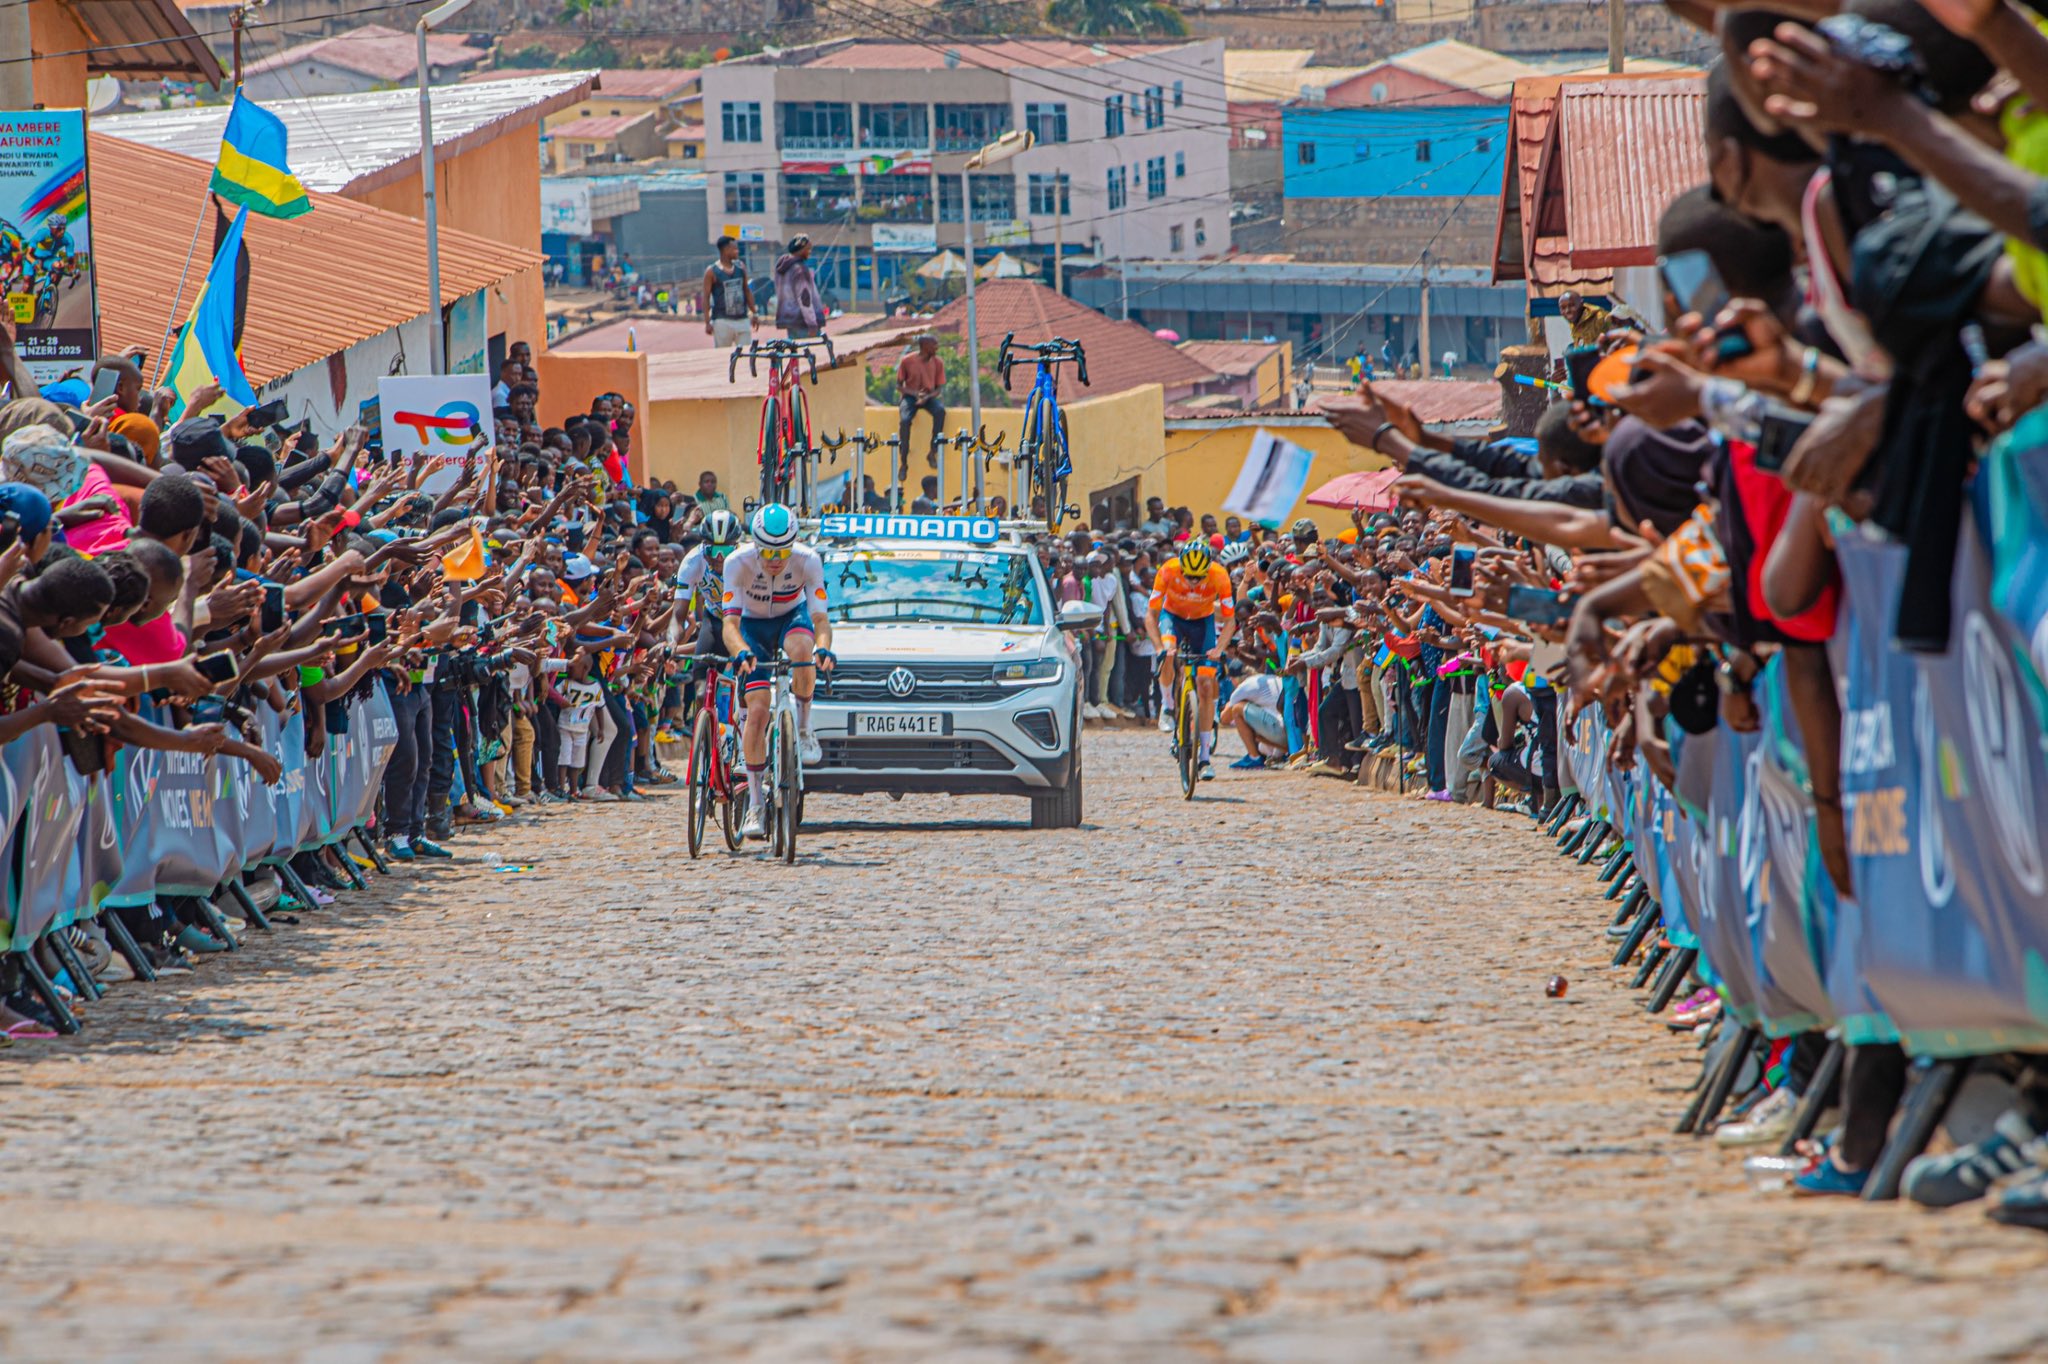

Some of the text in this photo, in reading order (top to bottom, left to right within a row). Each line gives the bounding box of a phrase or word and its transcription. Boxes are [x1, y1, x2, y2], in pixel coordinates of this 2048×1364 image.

[17, 122, 60, 133] MBERE
[0, 136, 61, 147] AFURIKA?
[23, 151, 59, 159] RWANDA
[28, 336, 38, 345] 21
[46, 336, 58, 345] 28
[27, 345, 82, 355] NZERI 2025
[823, 516, 996, 539] SHIMANO
[866, 716, 938, 733] RAG 441 E
